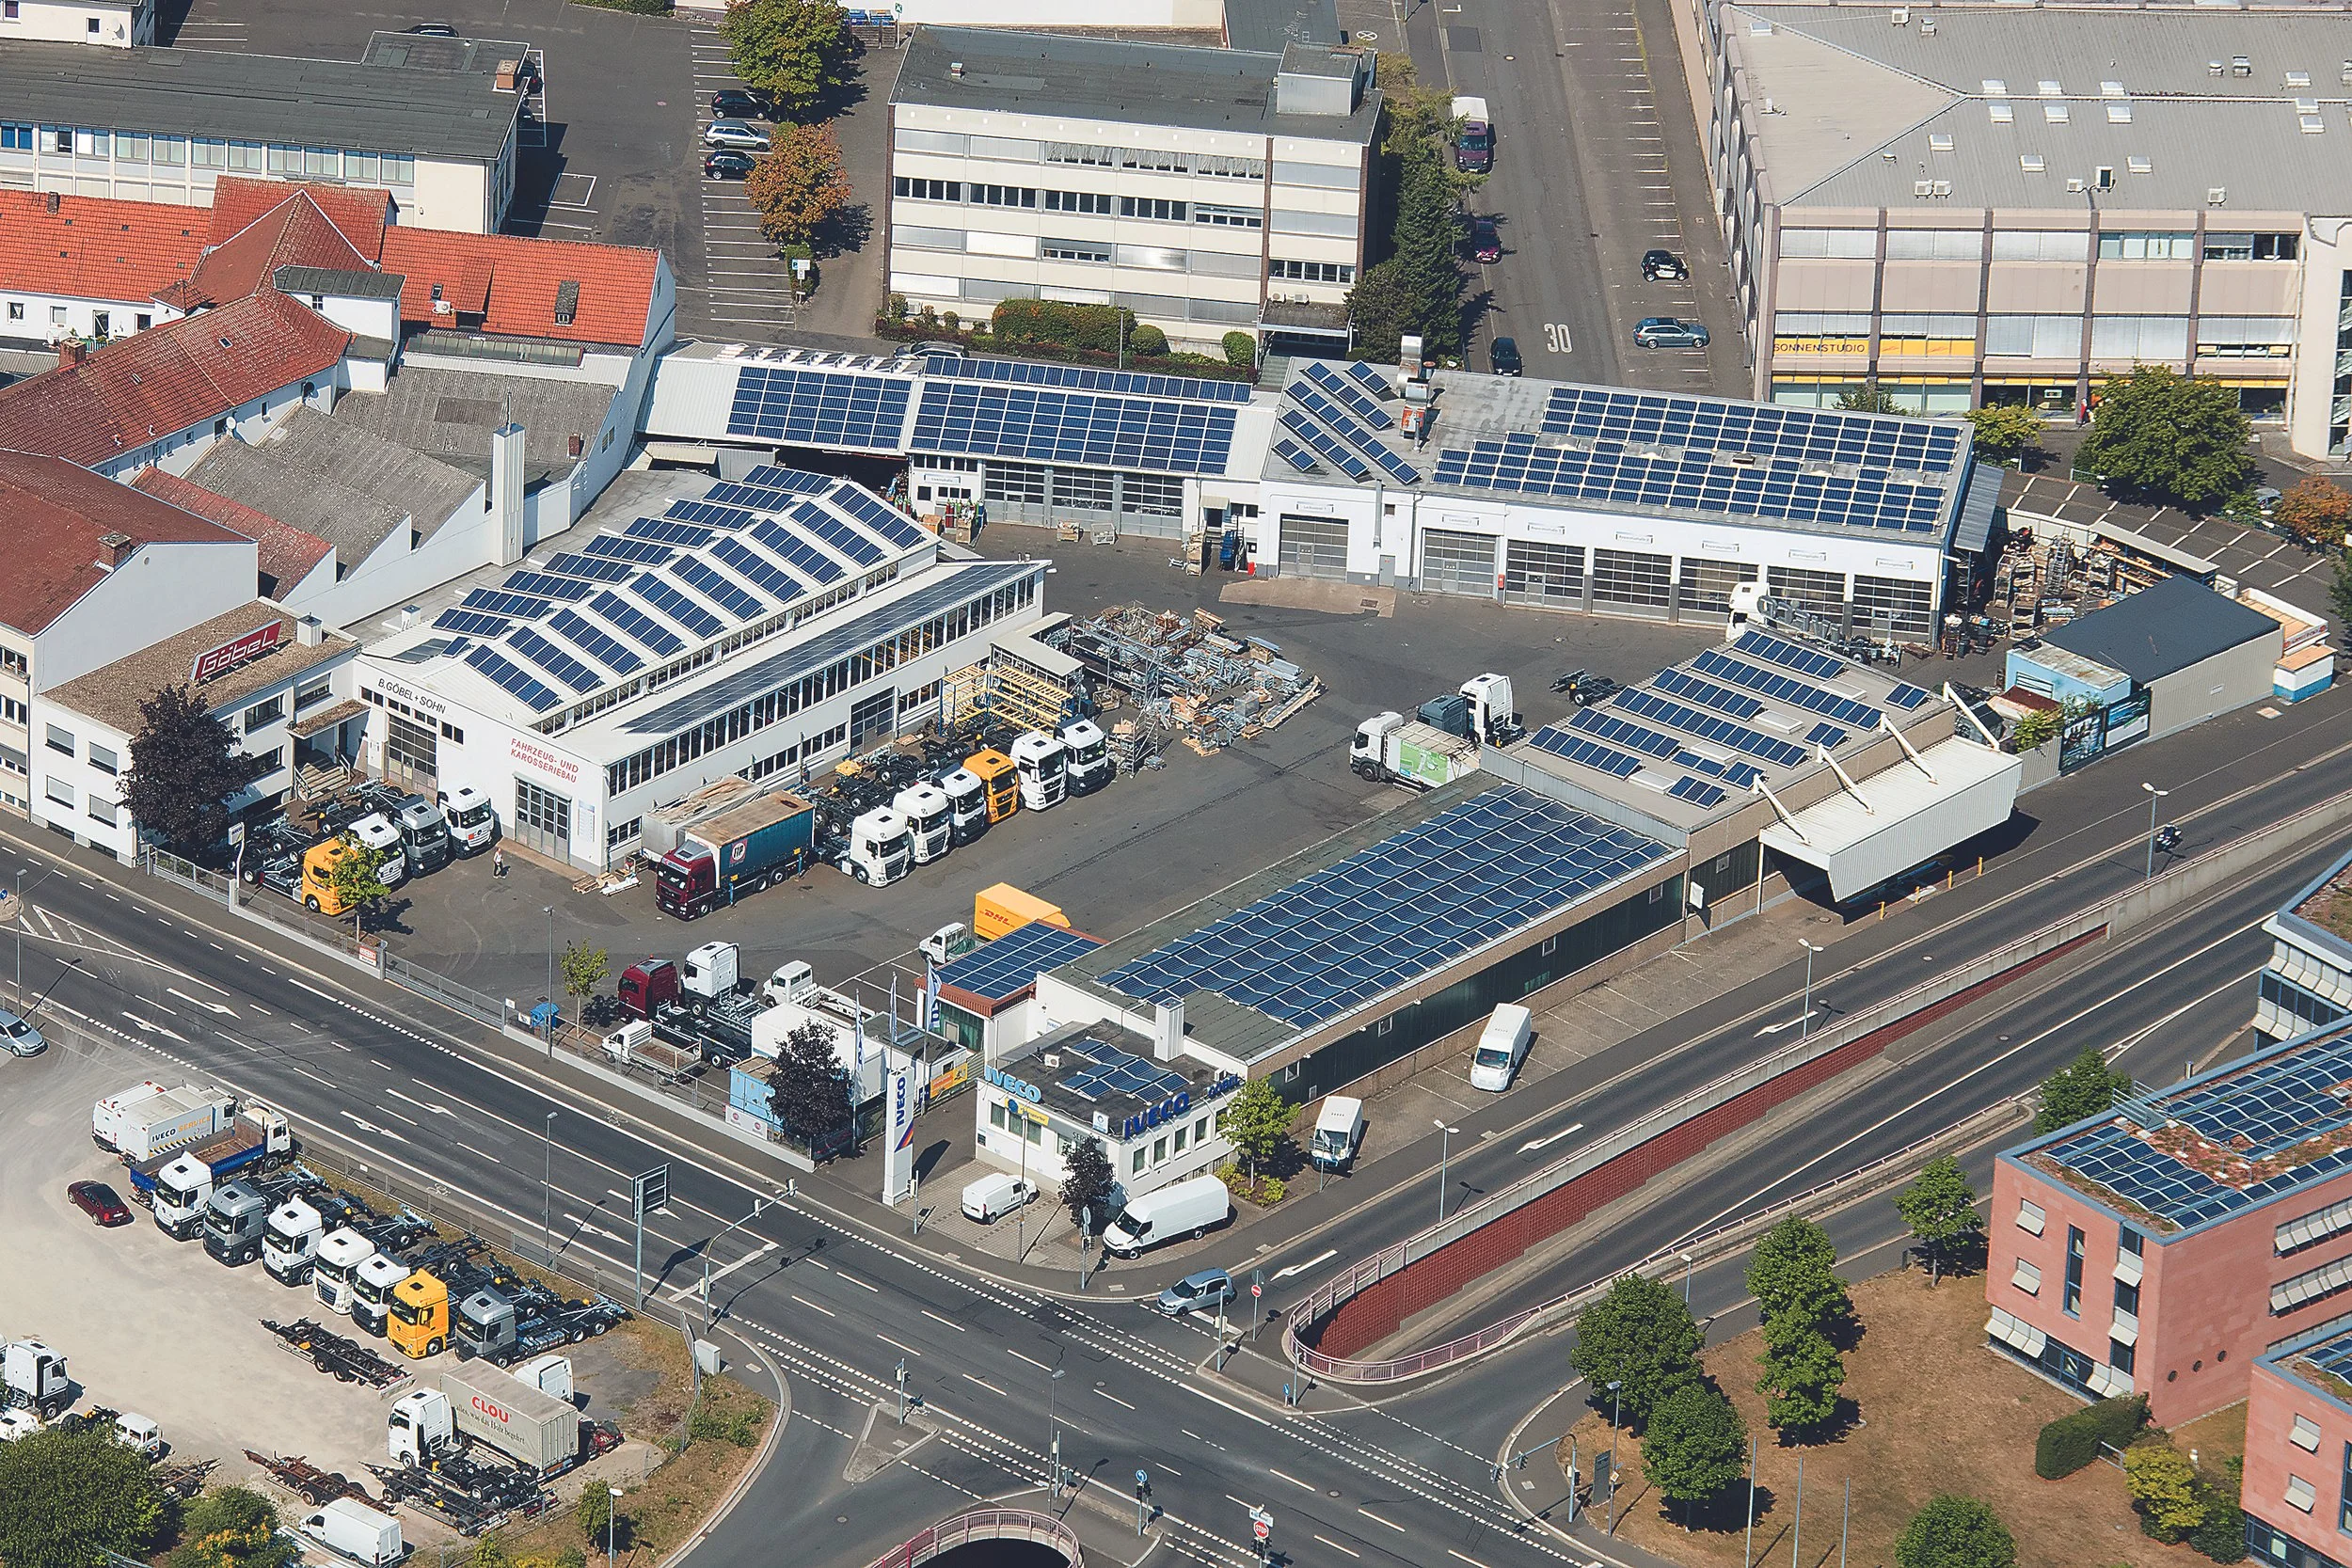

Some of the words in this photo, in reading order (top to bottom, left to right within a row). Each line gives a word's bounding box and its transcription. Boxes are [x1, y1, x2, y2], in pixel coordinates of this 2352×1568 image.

[1544, 324, 1572, 353] 30
[1773, 343, 1866, 353] SONNENSTUDIO
[420, 696, 446, 714] SOHN
[511, 737, 557, 763] FAHRZEUG-
[560, 759, 579, 773] UND
[511, 748, 577, 784] KAROSSERIEBAU
[984, 909, 1010, 926] DHL
[984, 1065, 1041, 1103] IVECO
[897, 1077, 906, 1127] IVECO
[1123, 1091, 1190, 1140] IVECO
[151, 1128, 176, 1142] IVECO
[178, 1115, 211, 1132] SERVICE
[471, 1396, 509, 1423] CLOU
